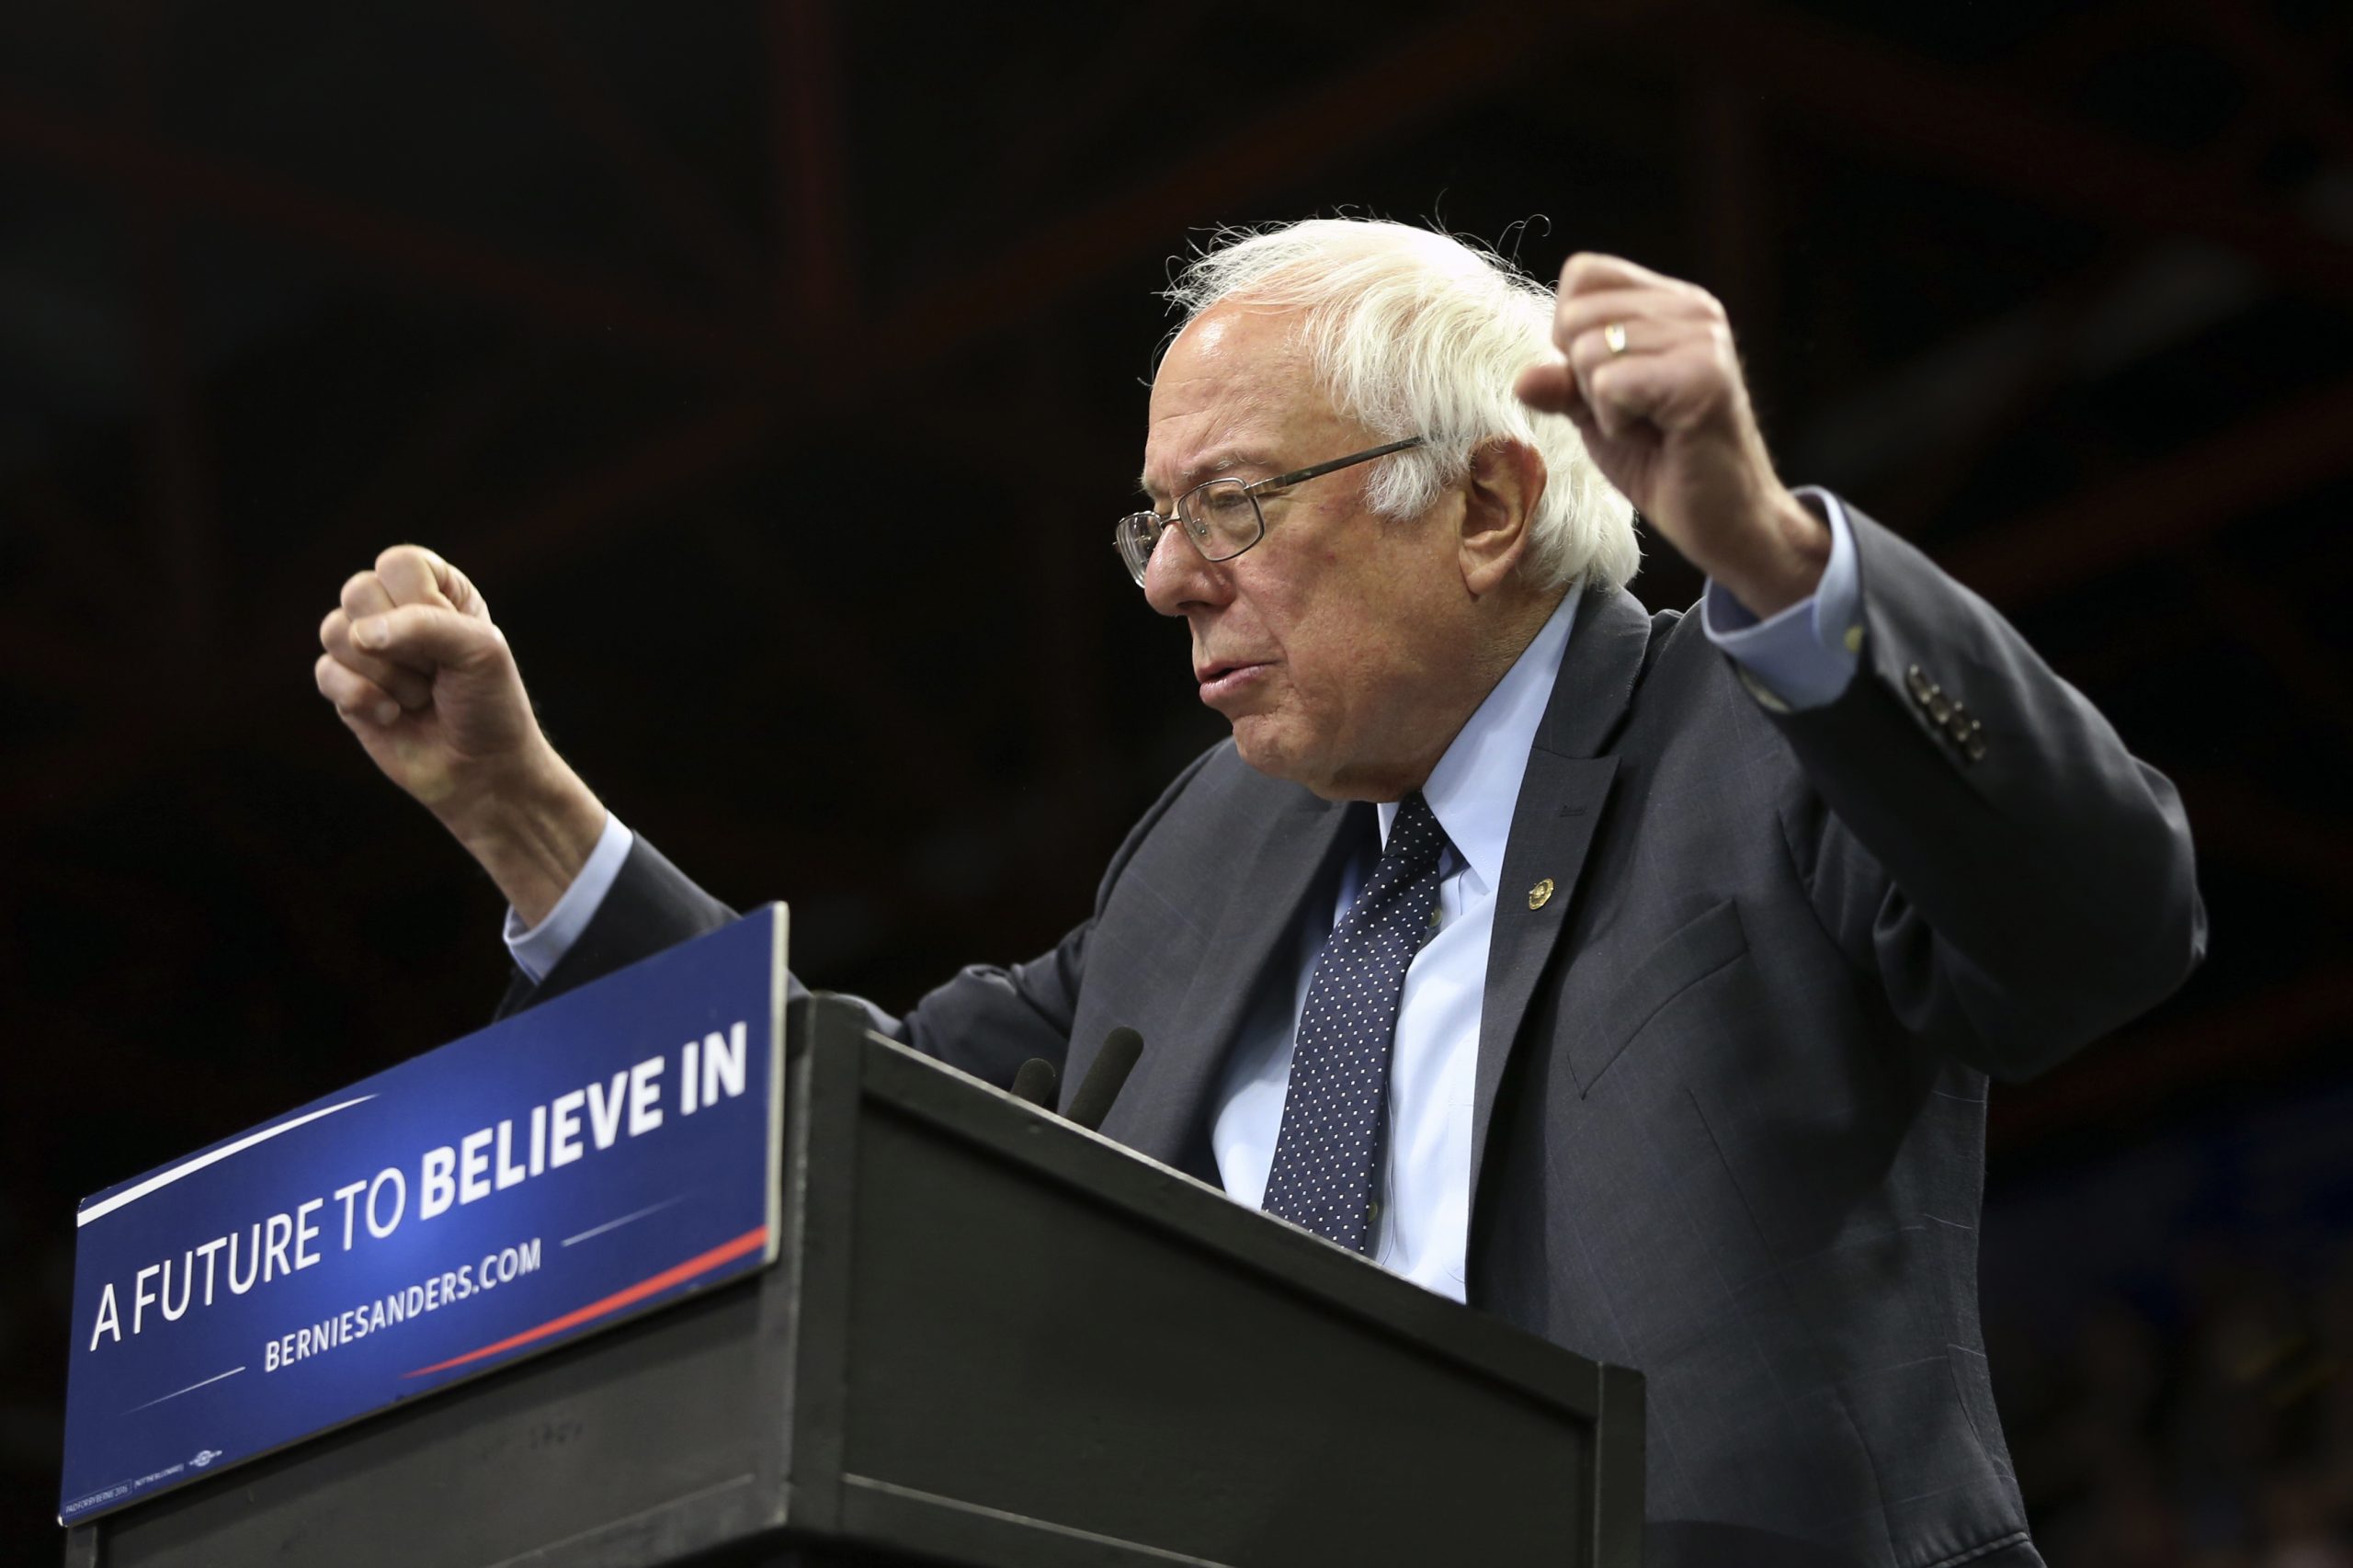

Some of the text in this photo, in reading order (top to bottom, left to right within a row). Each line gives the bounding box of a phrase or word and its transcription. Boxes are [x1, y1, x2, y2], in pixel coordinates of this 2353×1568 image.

[89, 1020, 748, 1353] A FUTURE TO BELIEVE IN
[263, 1236, 542, 1374] BERNIESANDERS.COM
